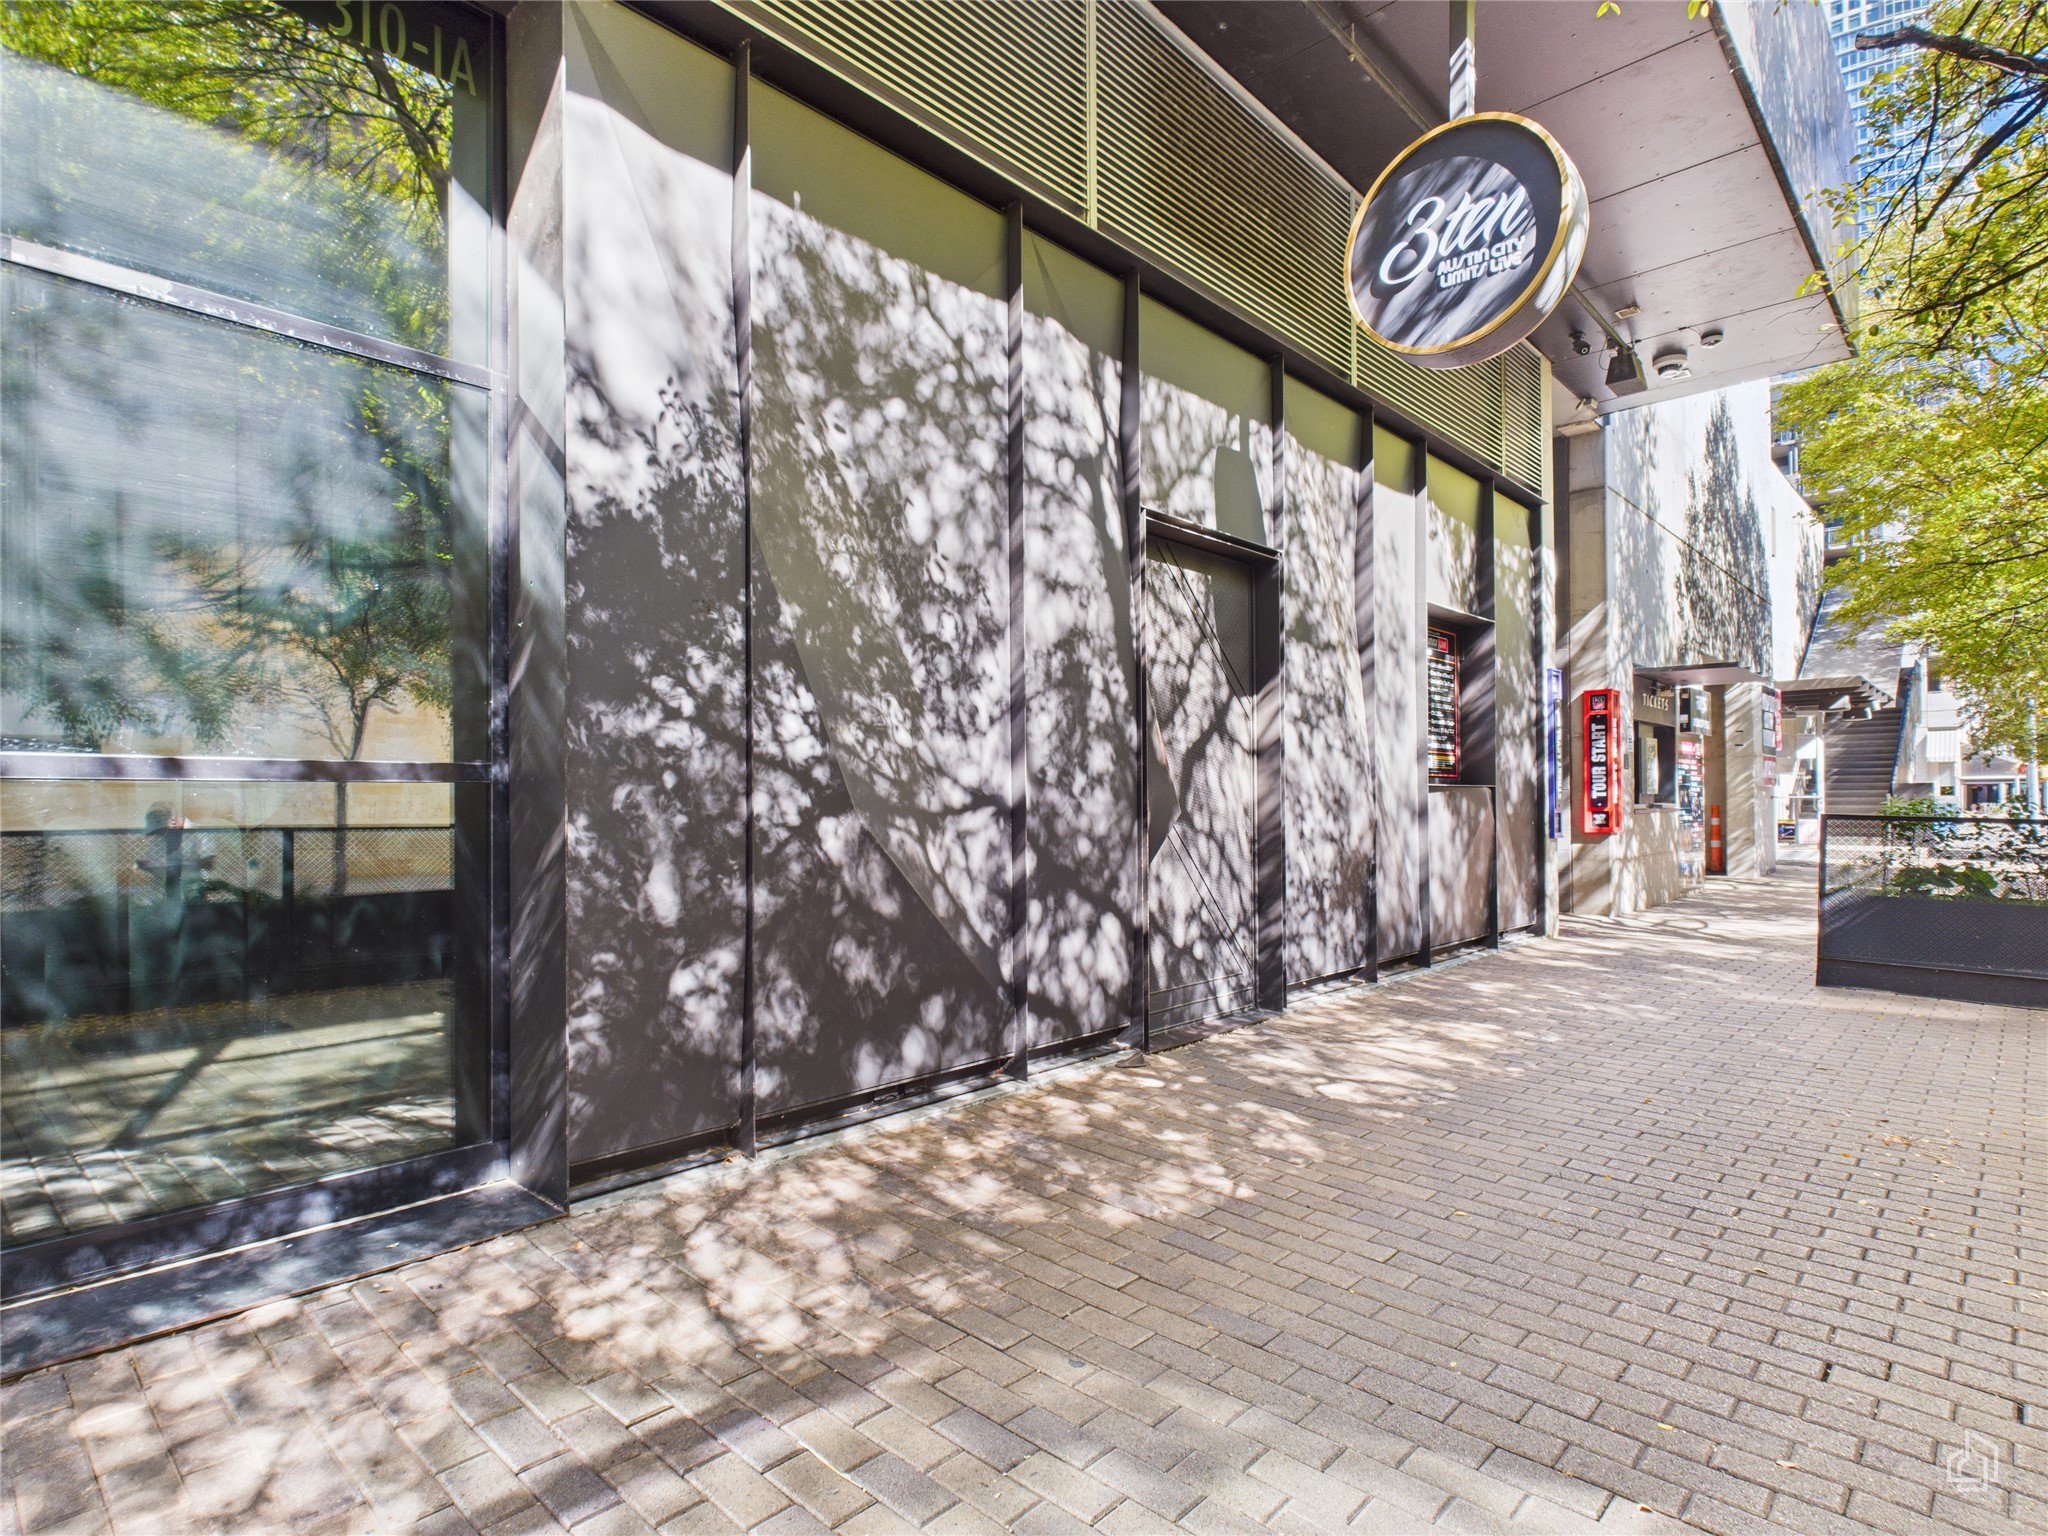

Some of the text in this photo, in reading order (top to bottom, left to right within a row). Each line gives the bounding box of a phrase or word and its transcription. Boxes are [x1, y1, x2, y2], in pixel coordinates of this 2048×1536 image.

[1379, 185, 1528, 285] 3ten
[1437, 235, 1526, 276] AUSTIN CITY
[1440, 261, 1488, 288] LIMITS
[1642, 693, 1669, 711] TICKETS
[1590, 723, 1607, 763] START
[1590, 766, 1607, 799] TOUR
